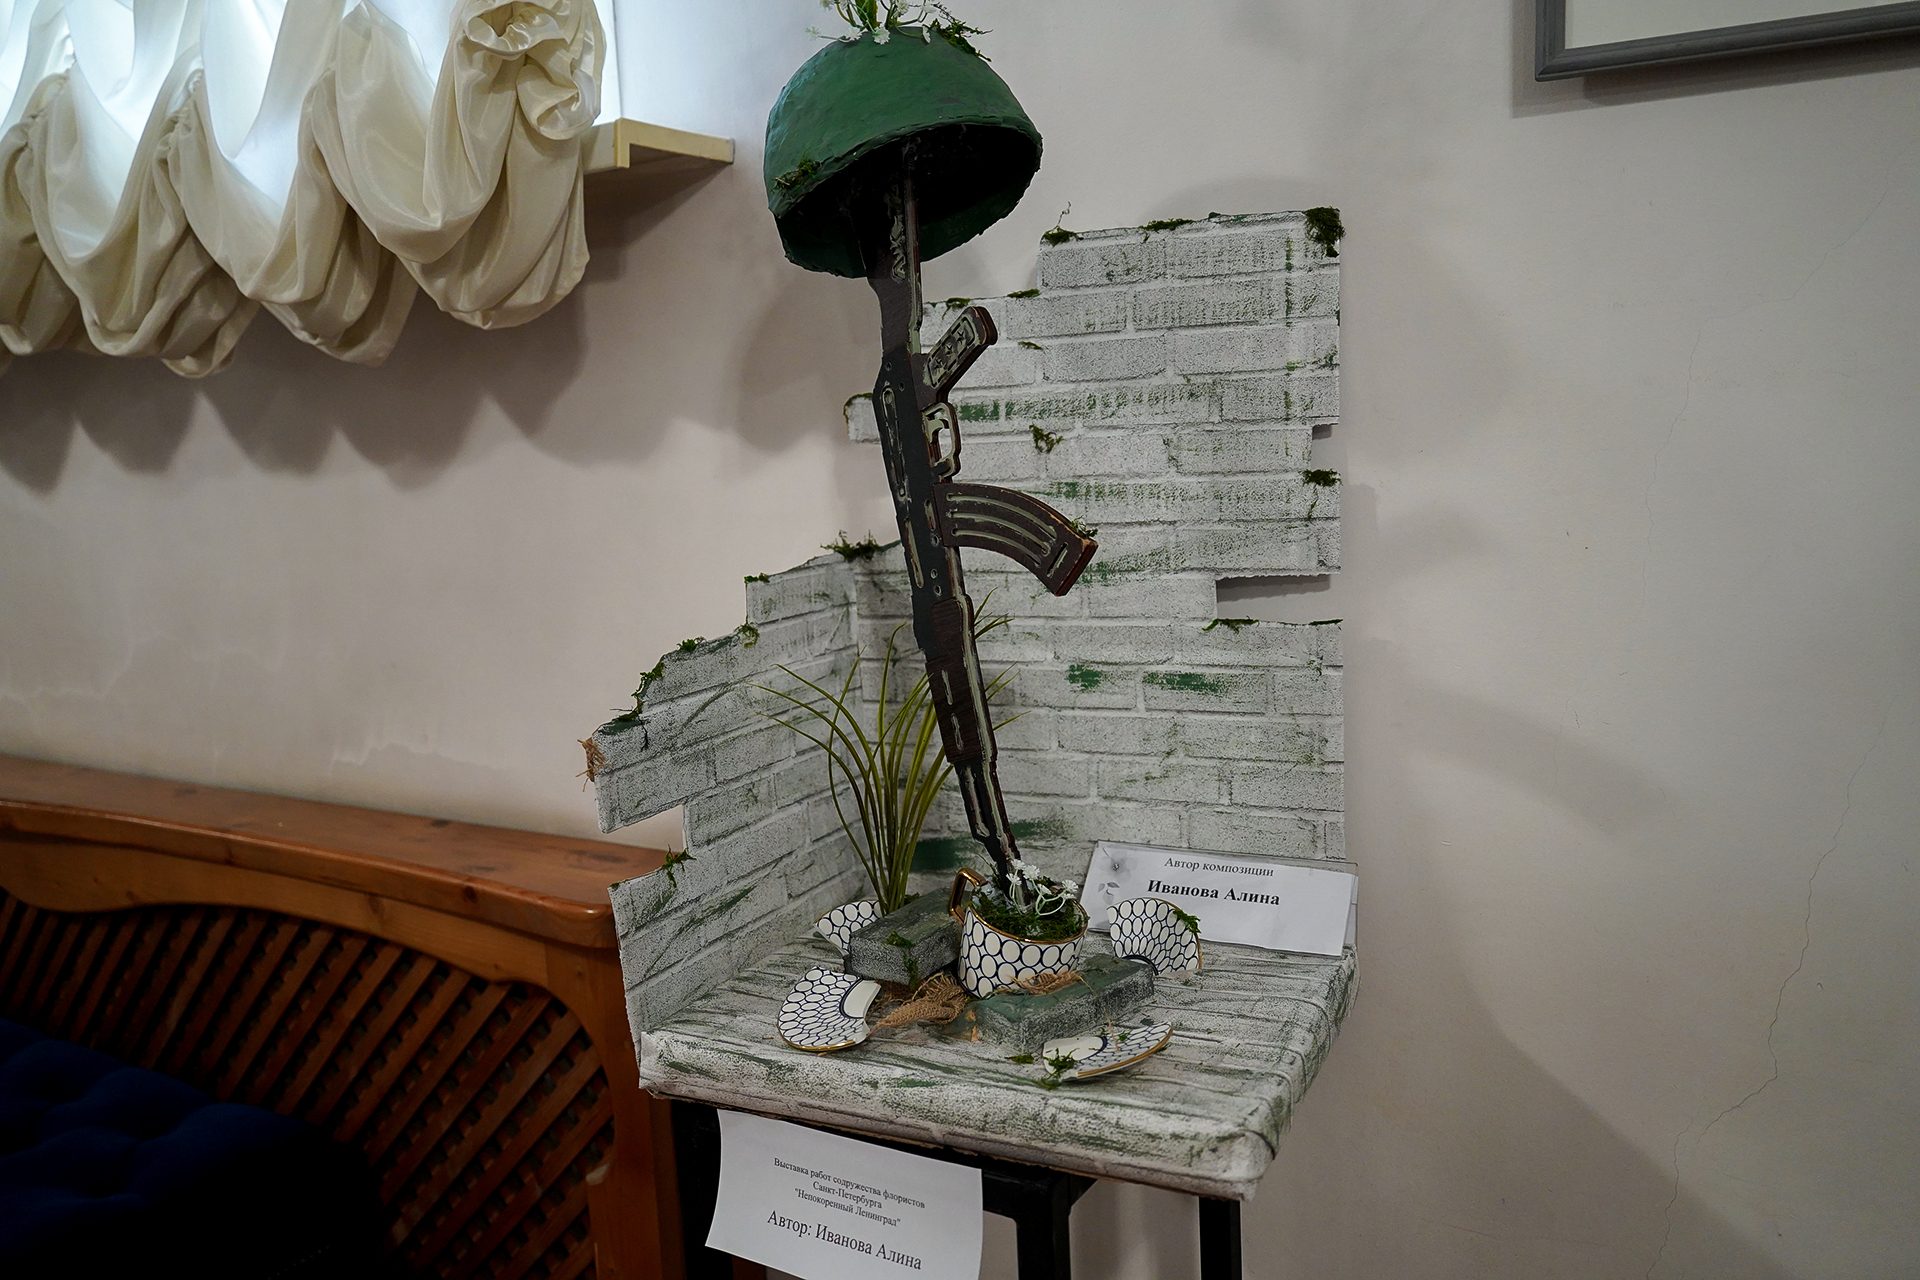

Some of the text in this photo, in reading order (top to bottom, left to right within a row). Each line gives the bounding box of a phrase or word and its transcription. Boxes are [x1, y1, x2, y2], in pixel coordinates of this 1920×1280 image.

[1164, 857, 1274, 877] Автор композиции
[1148, 880, 1280, 906] Иванова Алина
[774, 1157, 926, 1209] Выставка работ содружества флористов
[813, 1181, 882, 1209] Санкт-Петербурга
[767, 1210, 922, 1270] Автор: Иванова Алина
